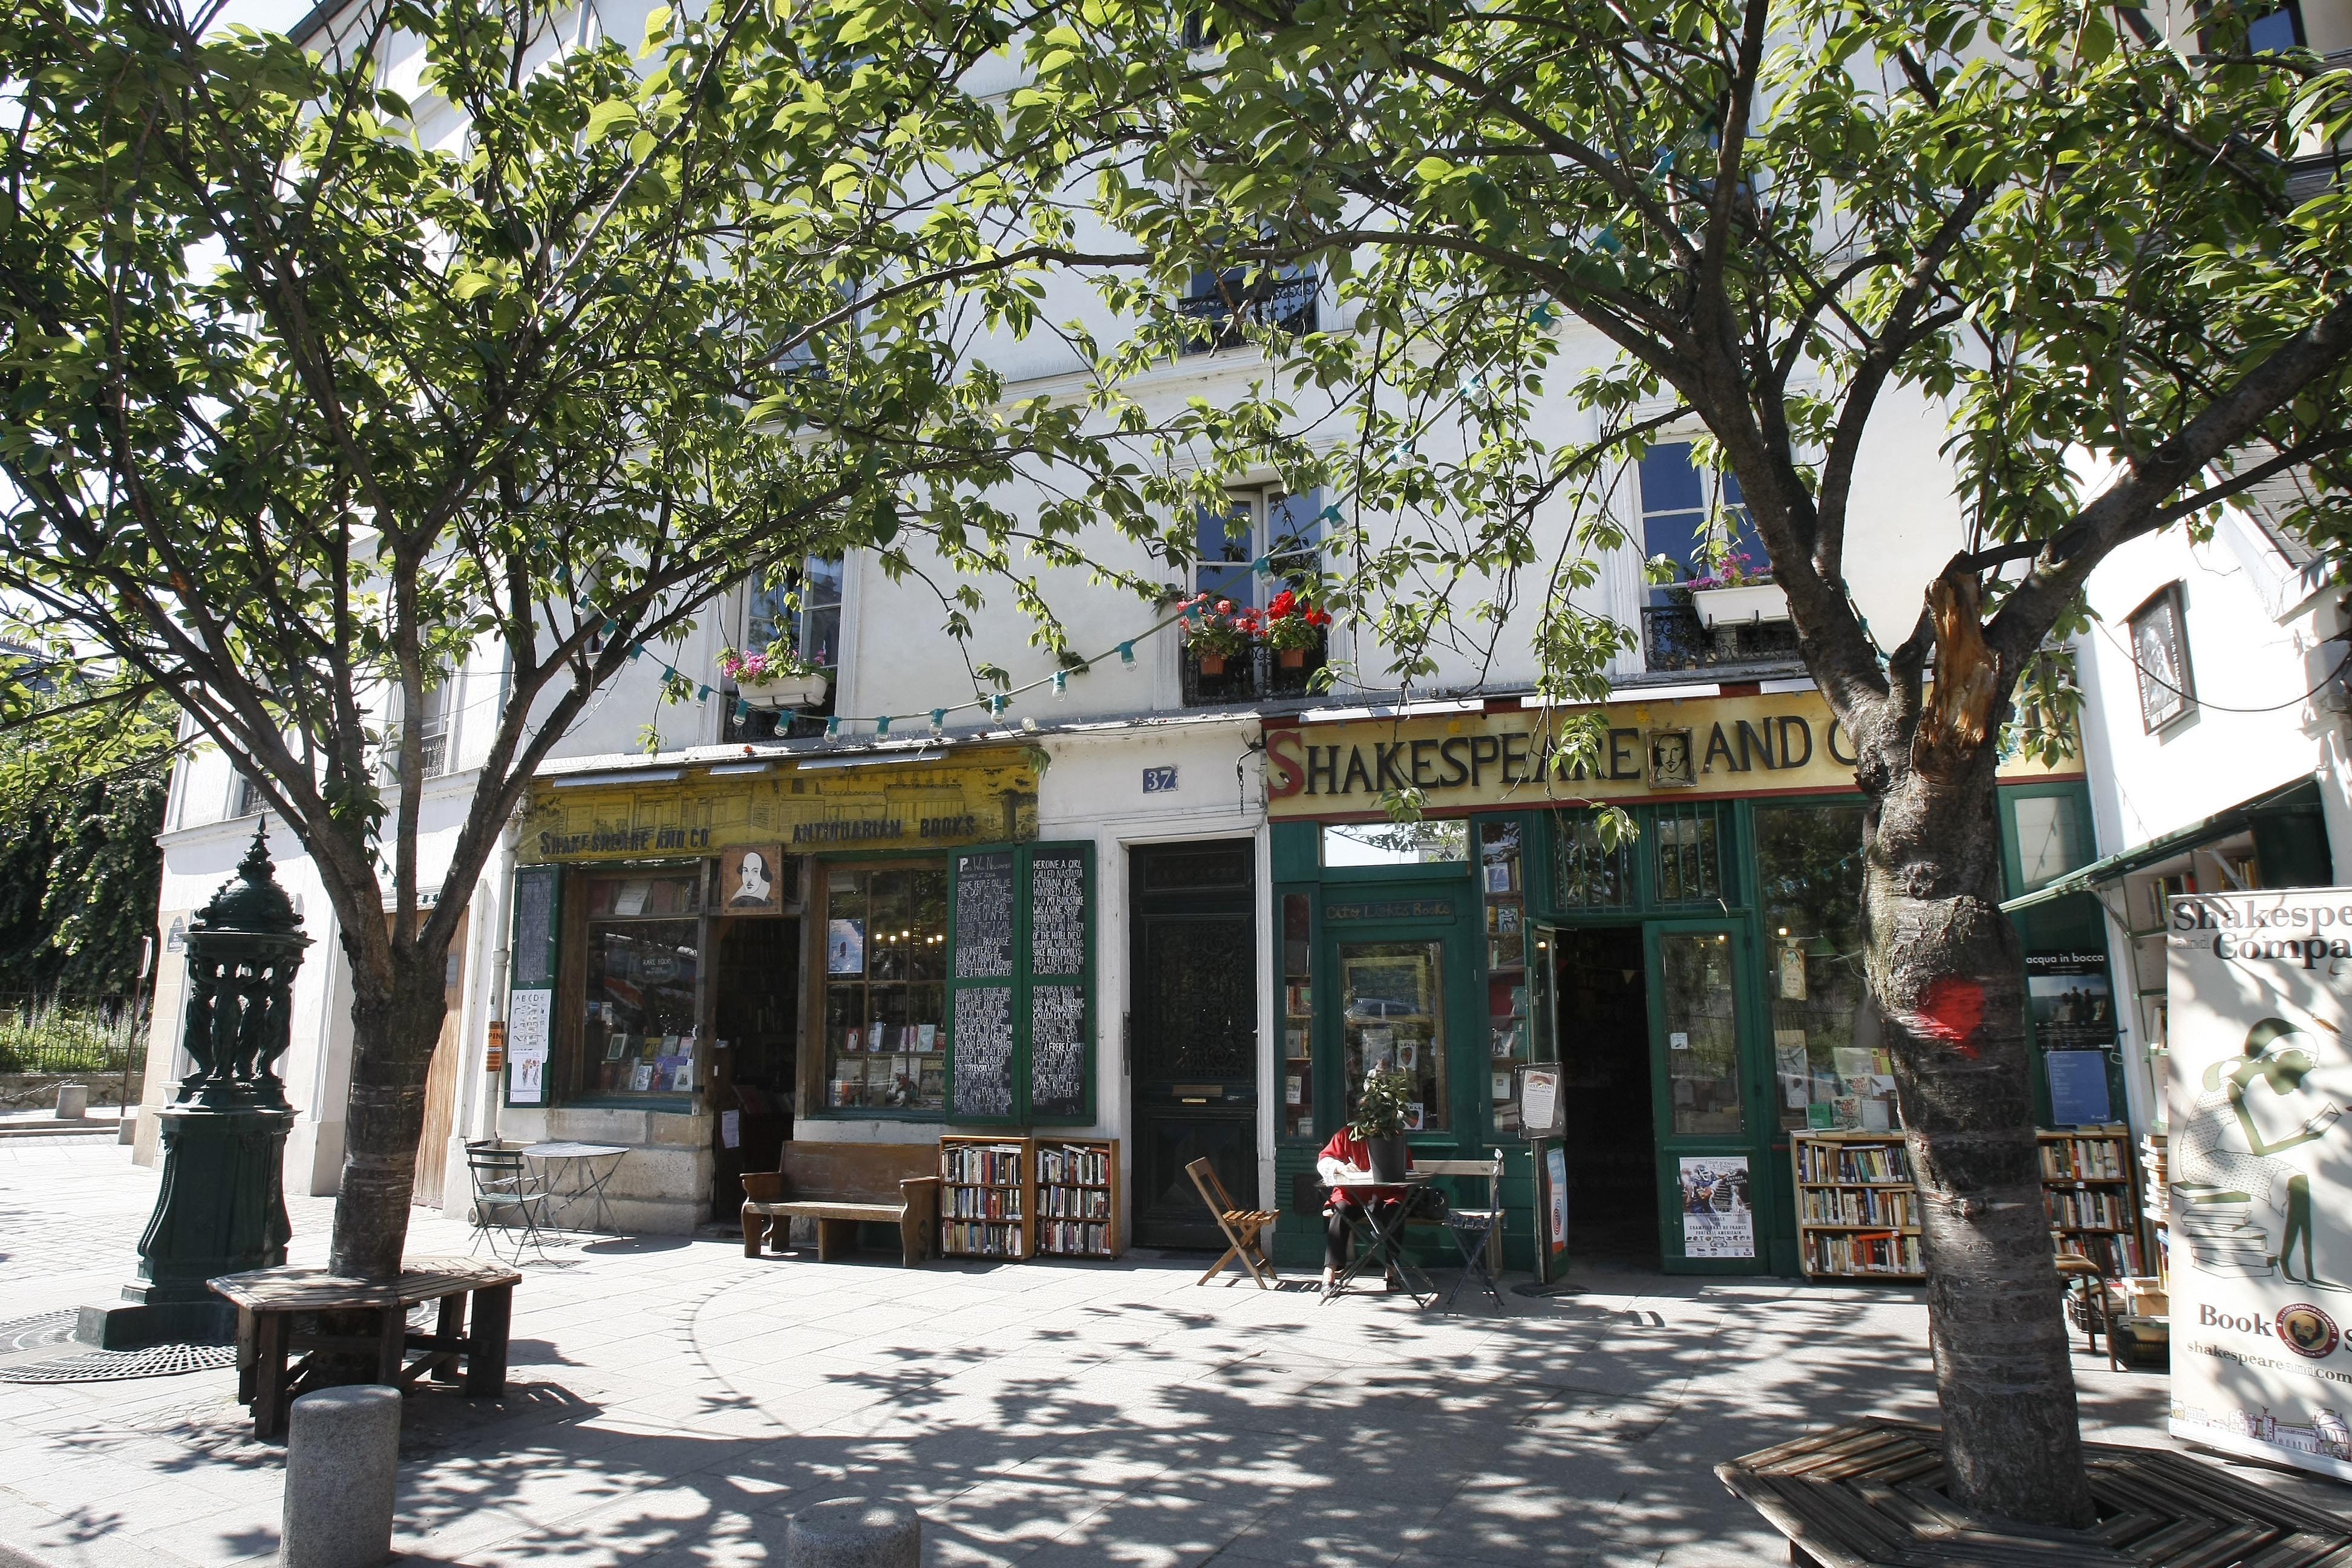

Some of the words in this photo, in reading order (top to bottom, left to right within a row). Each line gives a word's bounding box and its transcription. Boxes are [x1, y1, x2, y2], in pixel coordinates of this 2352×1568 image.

[1700, 715, 1812, 774] AND
[1148, 769, 1172, 789] 37
[920, 816, 976, 838] BOOKS
[655, 829, 686, 850] AND
[690, 828, 709, 848] CO
[1061, 860, 1066, 868] A
[1034, 870, 1055, 879] CALLED
[1065, 878, 1077, 887] ONE
[1033, 887, 1060, 897] HUNDRED
[1062, 887, 1082, 896] YEARS
[1047, 897, 1055, 906] MY
[1064, 905, 1080, 915] SHOP
[2174, 900, 2352, 937] Shakespe
[1040, 932, 1051, 940] THE
[2174, 935, 2210, 949] and
[2213, 932, 2352, 969] Compa
[2026, 956, 2057, 965] acqua
[2059, 953, 2069, 962] in
[2072, 952, 2105, 962] bocca
[2199, 1303, 2274, 1337] Book
